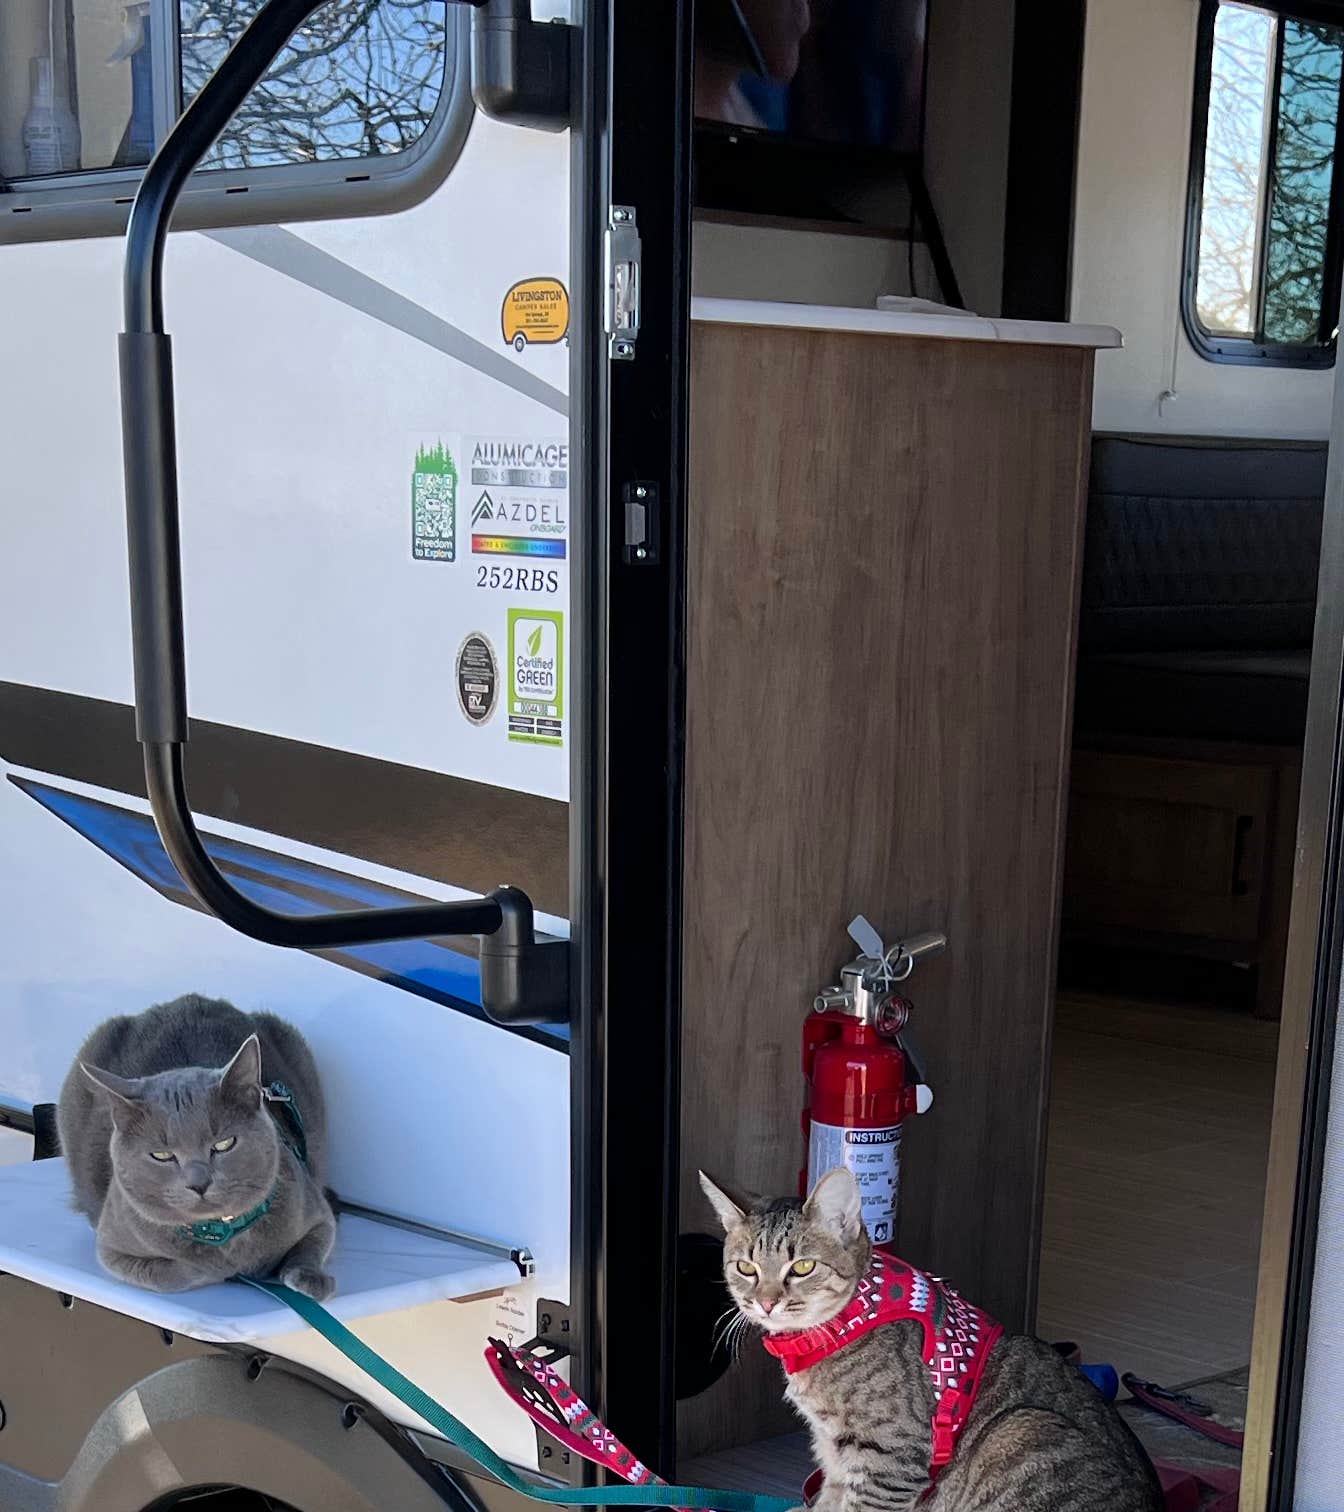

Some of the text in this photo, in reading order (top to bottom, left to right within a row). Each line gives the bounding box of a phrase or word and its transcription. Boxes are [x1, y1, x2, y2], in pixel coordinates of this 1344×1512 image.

[512, 290, 562, 302] LIVINGSTON
[472, 441, 568, 468] ALUMICAGE
[496, 503, 565, 524] AZDEL
[415, 538, 453, 549] Freedom
[424, 548, 453, 560] Explore
[476, 566, 559, 593] 252RBS
[517, 656, 553, 671] Certified
[517, 670, 553, 686] GREEN
